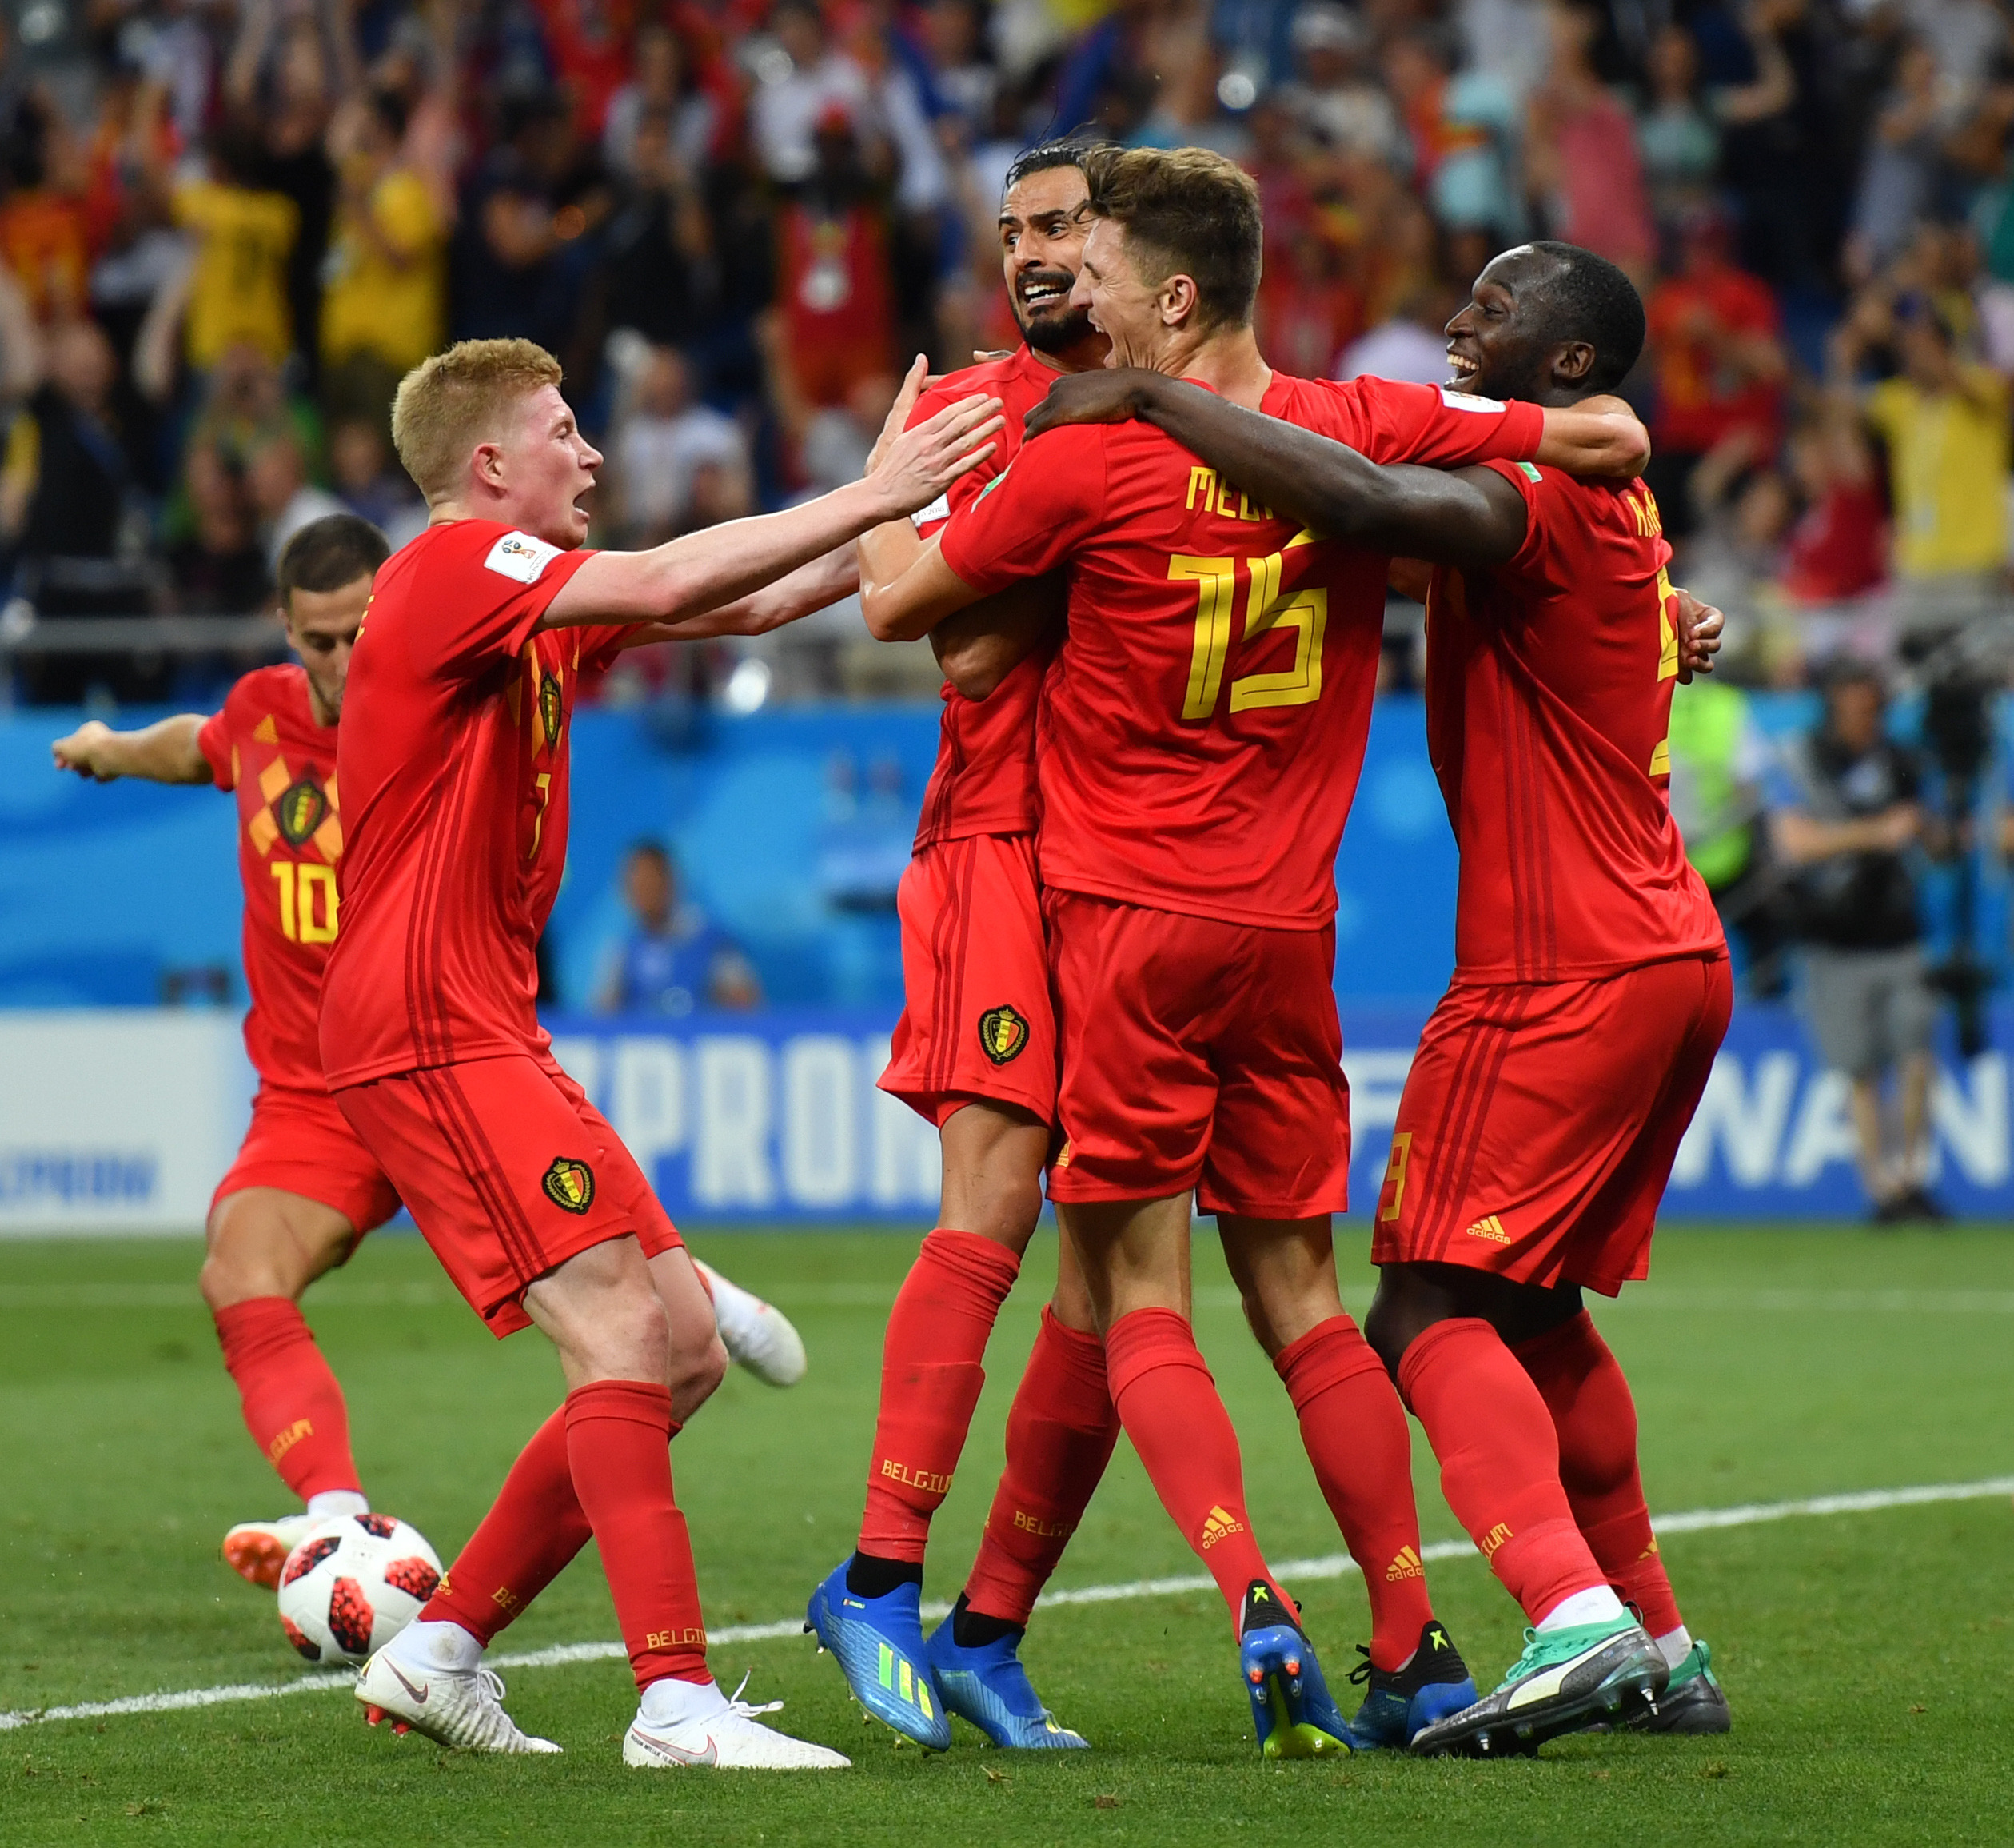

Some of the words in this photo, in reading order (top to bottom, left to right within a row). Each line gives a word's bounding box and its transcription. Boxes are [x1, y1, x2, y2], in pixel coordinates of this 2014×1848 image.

[1167, 529, 1327, 720] 15
[270, 861, 341, 944] 10
[1381, 1132, 1413, 1222] 9
[1466, 1227, 1512, 1246] adidas
[1202, 1522, 1245, 1550] adidas
